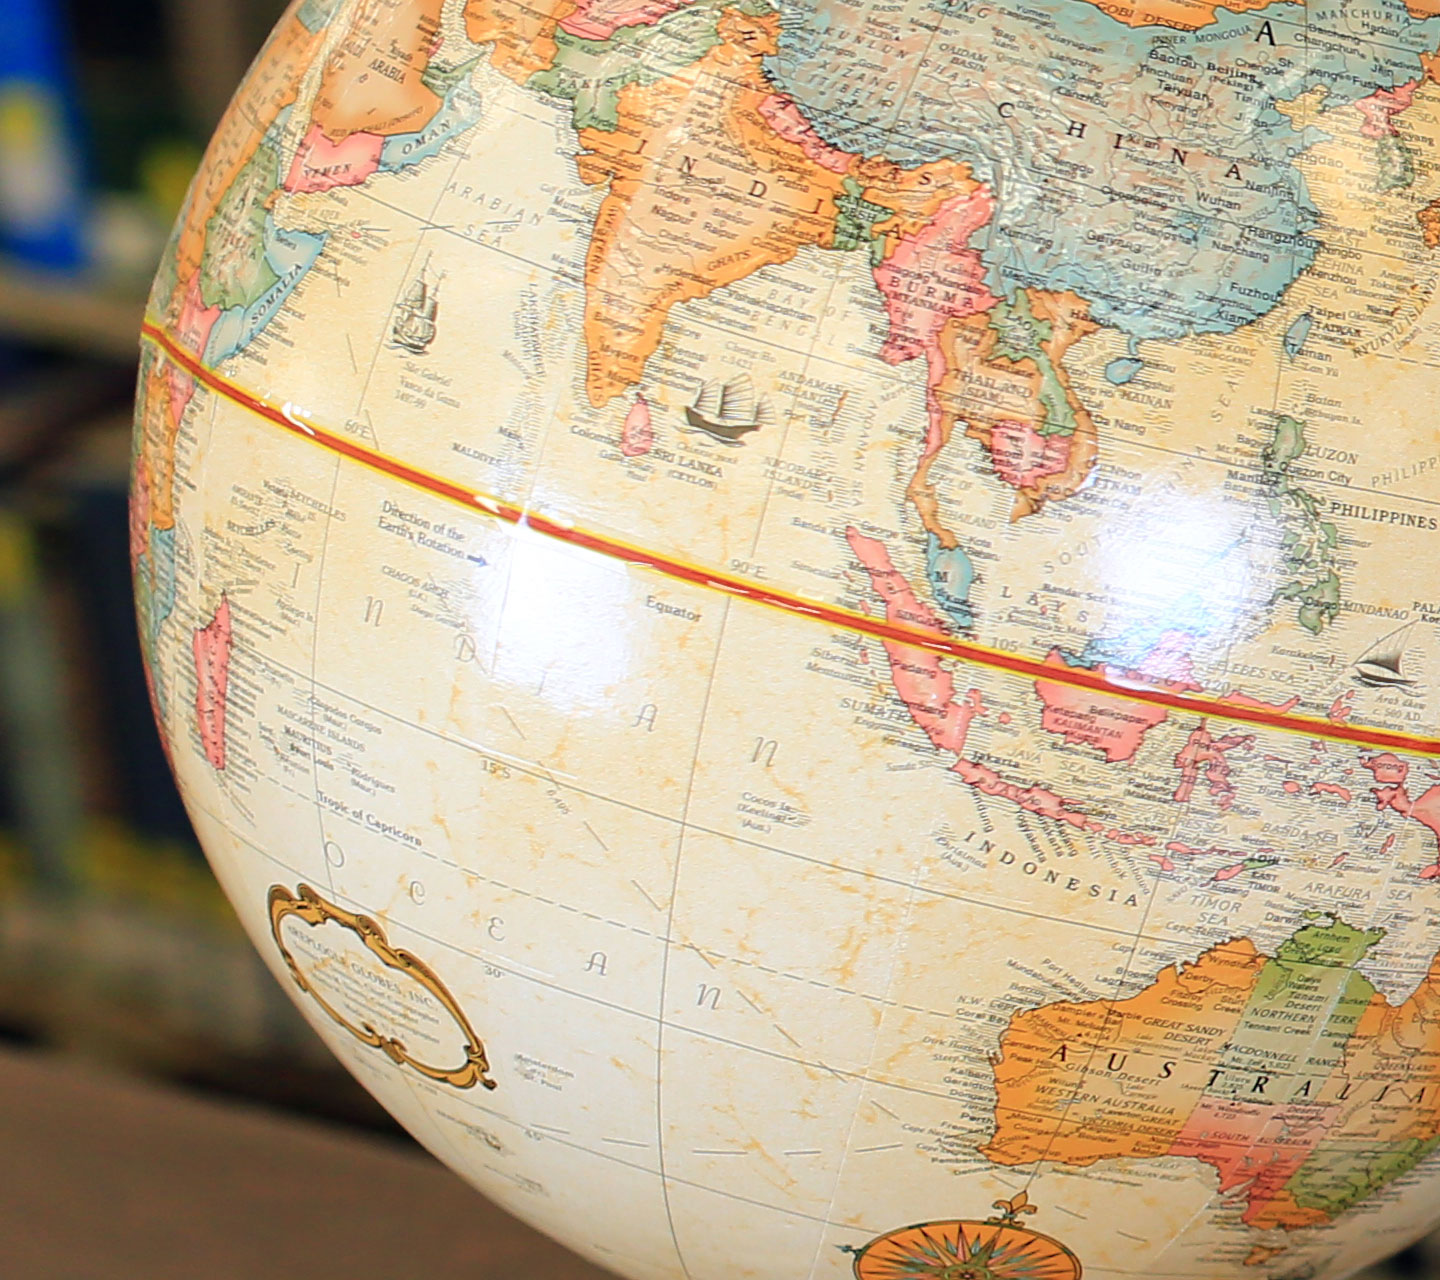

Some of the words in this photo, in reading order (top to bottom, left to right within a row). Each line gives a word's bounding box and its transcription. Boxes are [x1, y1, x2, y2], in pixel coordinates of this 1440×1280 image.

[1098, 1, 1134, 20] GOBI
[368, 58, 407, 85] ARABIA
[401, 119, 452, 156] OMAN
[997, 102, 1243, 181] CHINA
[653, 186, 692, 206] Indore
[776, 174, 811, 195] Patna
[1196, 191, 1242, 211] Wuhan
[1248, 227, 1316, 251] Hangzhou
[1211, 240, 1271, 263] Nanchang
[250, 262, 304, 327] SOMALIA
[888, 275, 976, 309] BURMA
[1229, 282, 1283, 302] Fuzhou
[675, 452, 723, 480] LANKA
[1327, 468, 1353, 485] City
[381, 499, 430, 529] Direction
[432, 522, 447, 534] of
[448, 529, 466, 543] the
[1329, 501, 1439, 531] PHILIPPINES
[377, 515, 416, 541] Earth's
[417, 531, 467, 560] Rotation
[646, 594, 703, 623] Equator
[316, 790, 350, 814] Tropic
[351, 807, 365, 820] of
[365, 813, 423, 847] Capricorn
[962, 830, 1140, 908] INDONESIA
[1189, 894, 1242, 914] TIMOR
[1303, 882, 1372, 901] ARAFURA
[1387, 889, 1413, 903] SEA
[1198, 913, 1229, 927] SEA
[1185, 970, 1214, 986] Derby
[1250, 1006, 1317, 1023] NORTHERN
[1141, 1016, 1184, 1031] GREAT
[1184, 1023, 1227, 1038] SANDY
[1163, 1031, 1213, 1047] DESERT
[1049, 1043, 1426, 1103] AUSTRALIA
[1034, 1084, 1098, 1104] WESTERN
[1099, 1095, 1177, 1116] AUSTRALIA
